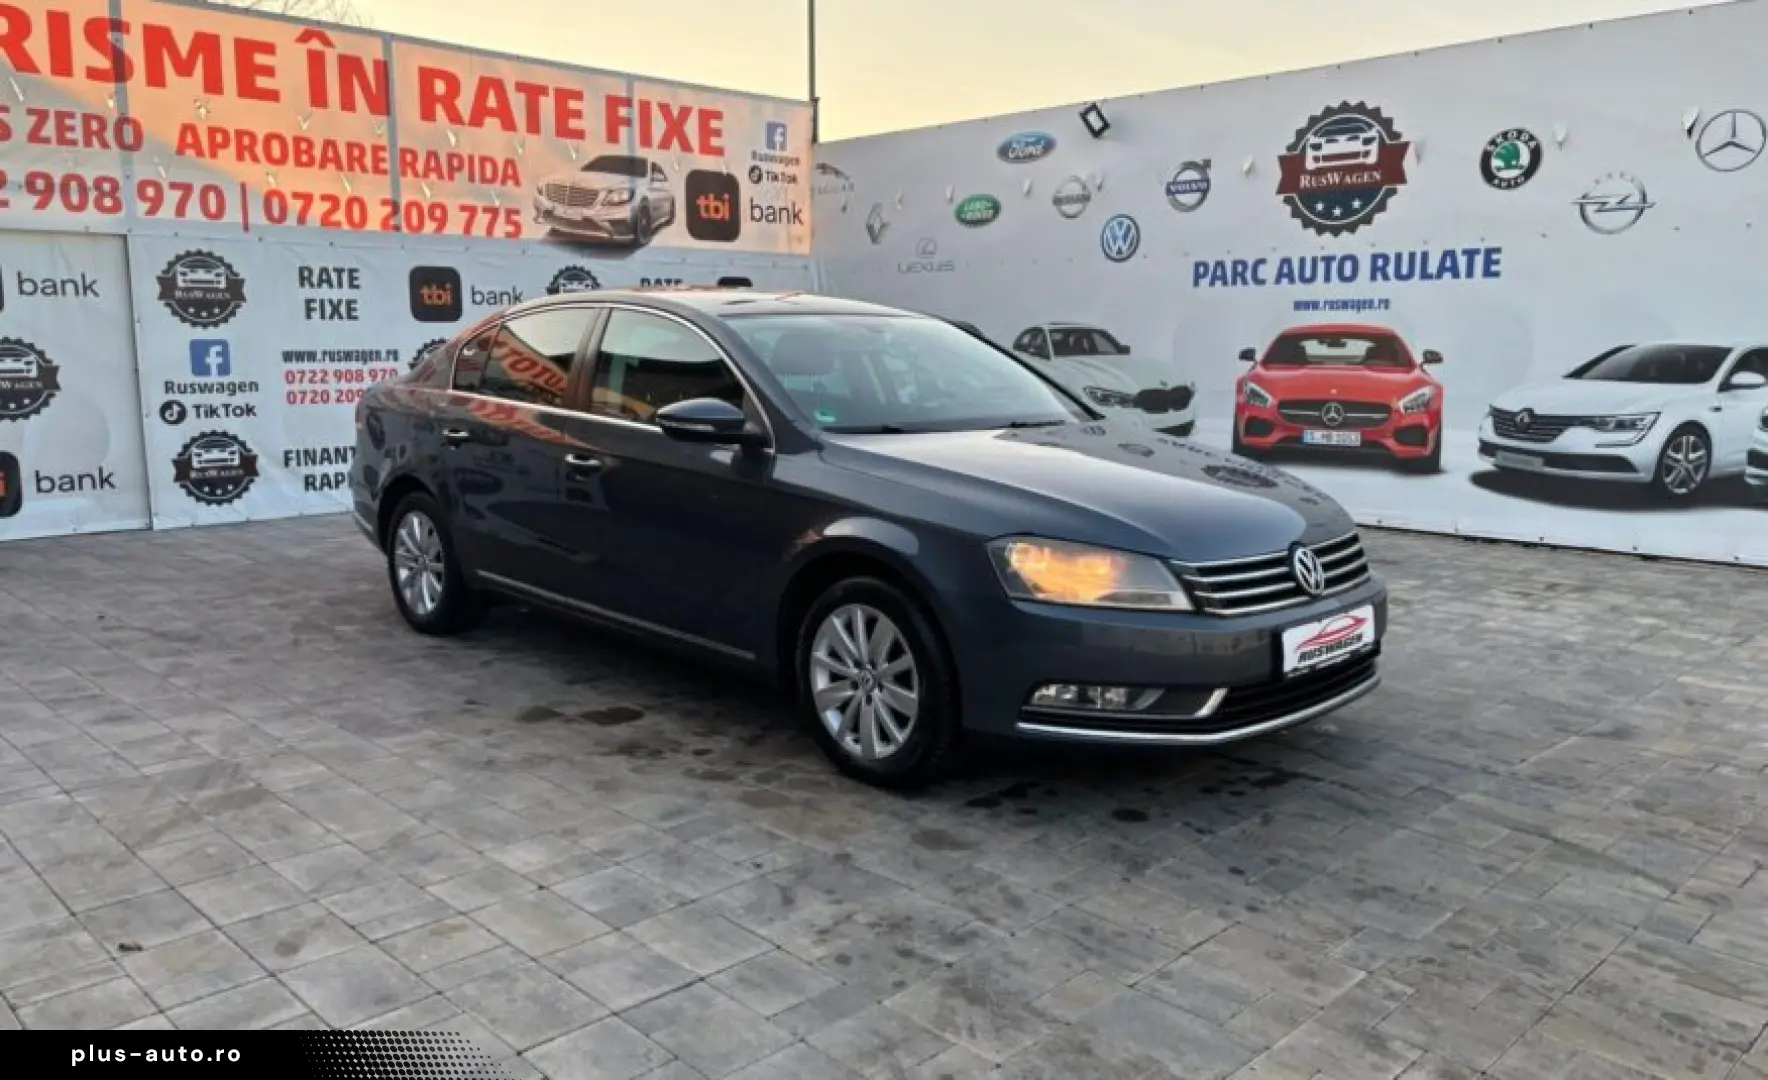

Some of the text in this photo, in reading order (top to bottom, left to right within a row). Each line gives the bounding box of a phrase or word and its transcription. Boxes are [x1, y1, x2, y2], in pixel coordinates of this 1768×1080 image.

[295, 28, 392, 117] ÎN
[418, 66, 586, 140] RATE
[604, 94, 726, 157] FIXE
[26, 107, 144, 152] ZERO
[175, 122, 388, 175] APROBARE
[400, 146, 522, 188] RAPIDA
[1169, 180, 1209, 193] VOLVO
[25, 170, 123, 215] 908
[137, 179, 226, 221] 970
[263, 189, 368, 230] 0720
[380, 199, 448, 234] 209
[459, 203, 522, 238] 775
[697, 194, 730, 221] tbi
[750, 196, 804, 226] bank
[299, 265, 361, 290] RATE
[1193, 247, 1502, 287] PARC AUTO RULATE
[17, 271, 100, 298] bank
[419, 283, 452, 305] tbi
[471, 285, 524, 306] bank
[305, 298, 359, 321] FIXE
[1293, 297, 1390, 313] www.ruswagen.ro
[282, 349, 399, 365] www.ruswagen.ro
[164, 380, 259, 396] Ruswagen
[285, 370, 329, 384] 0722
[333, 369, 364, 383] 908
[286, 389, 330, 405] 0720
[35, 466, 116, 493] bank
